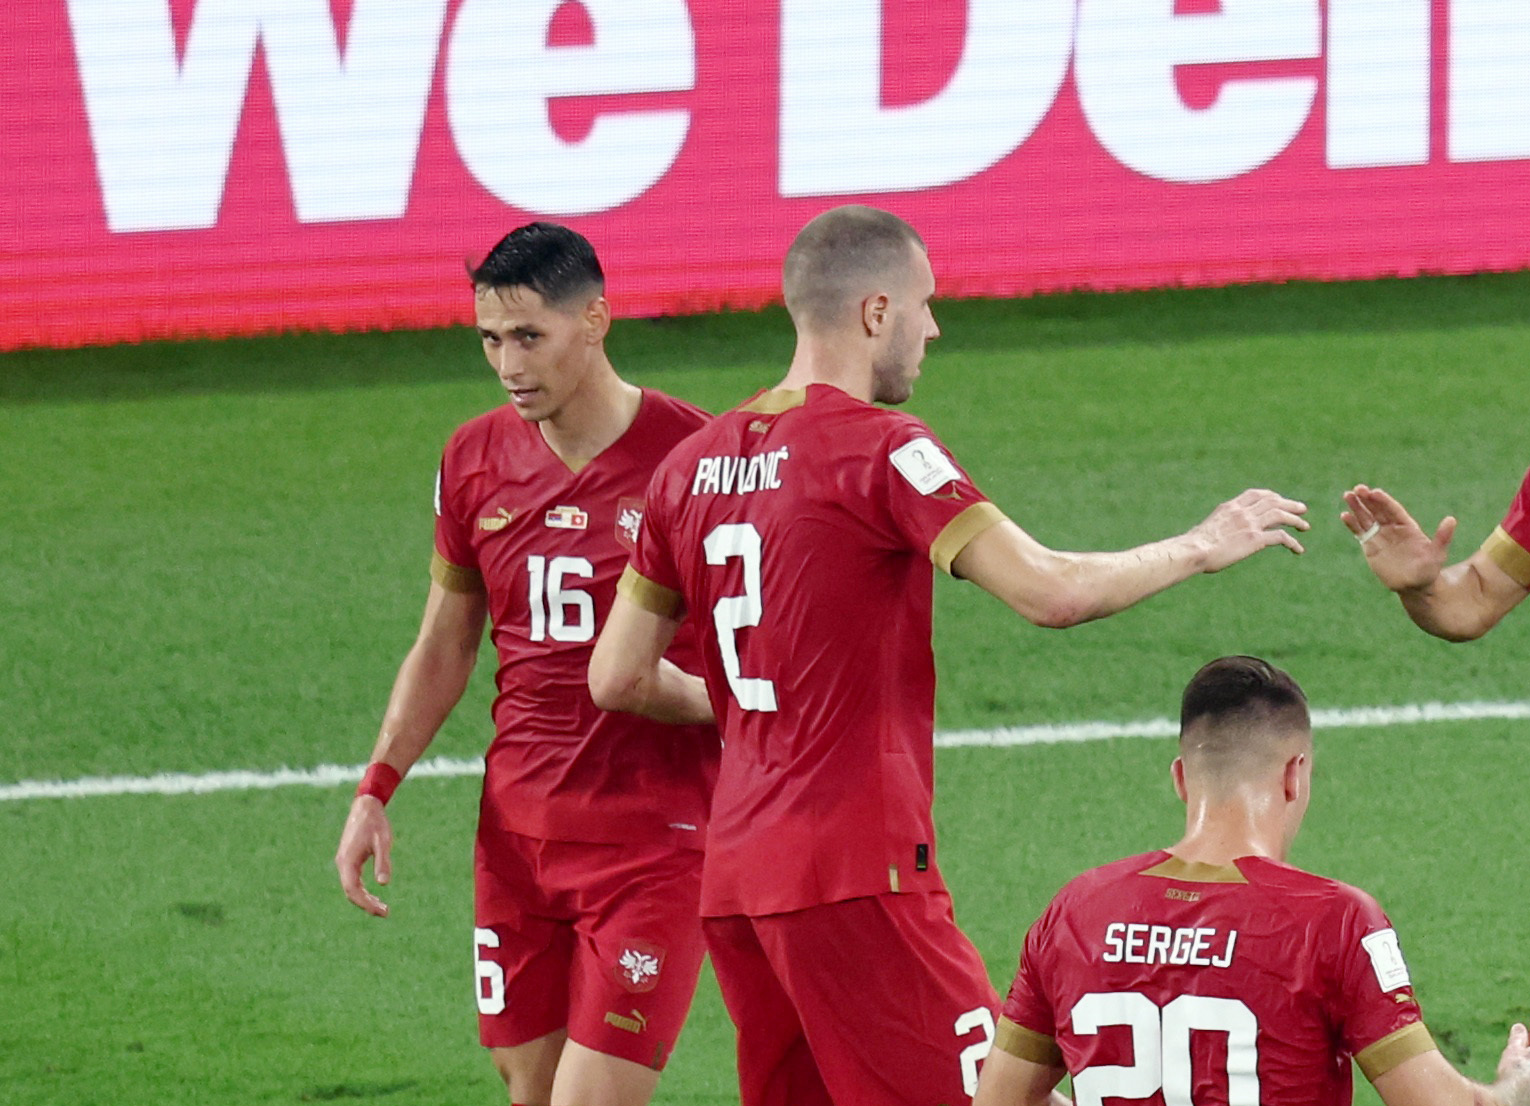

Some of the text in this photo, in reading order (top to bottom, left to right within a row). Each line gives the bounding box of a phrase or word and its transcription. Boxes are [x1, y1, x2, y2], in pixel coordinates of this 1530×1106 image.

[67, 0, 695, 233] We
[528, 556, 594, 642] 16
[703, 523, 777, 711] 2
[1103, 923, 1236, 967] SERGEJ
[954, 1006, 995, 1098] 2
